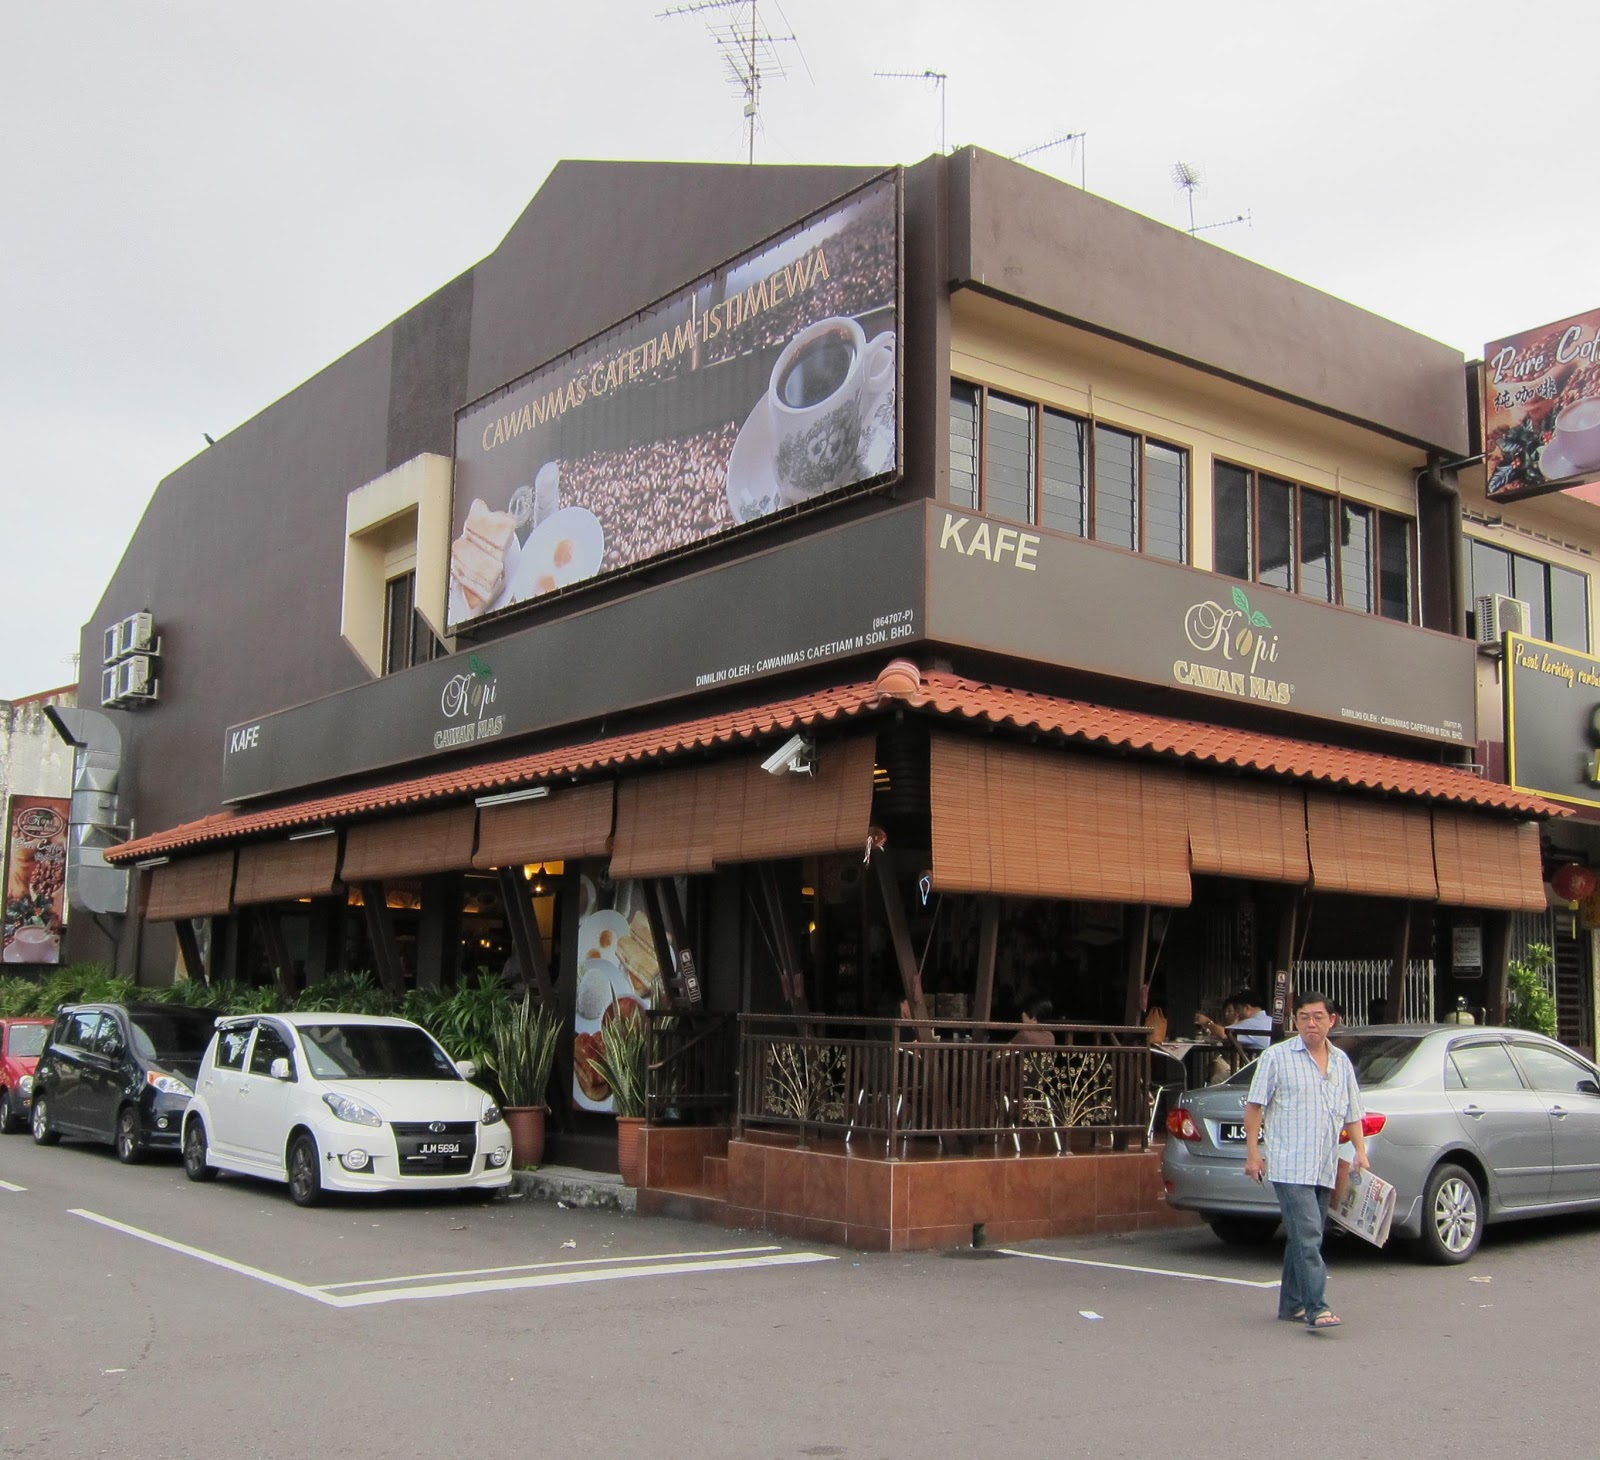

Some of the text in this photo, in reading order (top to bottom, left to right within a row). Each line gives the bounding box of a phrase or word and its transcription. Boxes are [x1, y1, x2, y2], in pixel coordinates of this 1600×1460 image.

[482, 248, 830, 452] CAWANMAS CAFETIAM ISTIMEWA
[1490, 324, 1600, 384] Pure Cof
[939, 513, 1041, 571] KAFE
[872, 609, 914, 630] (864707-P)
[1184, 600, 1279, 674] Kopi
[695, 669, 727, 687] DIMILIKI
[727, 664, 751, 680] OLEH
[756, 650, 806, 672] CAWANMAS
[807, 638, 854, 660] CAFETIAM
[855, 636, 864, 649] M
[865, 630, 888, 646] SDN.
[890, 624, 915, 640] BHD.
[1173, 660, 1291, 705] CAWAN MAS
[230, 725, 261, 753] KAFE
[433, 715, 503, 749] CAWAN MAS
[419, 1143, 459, 1153] JLM 5694
